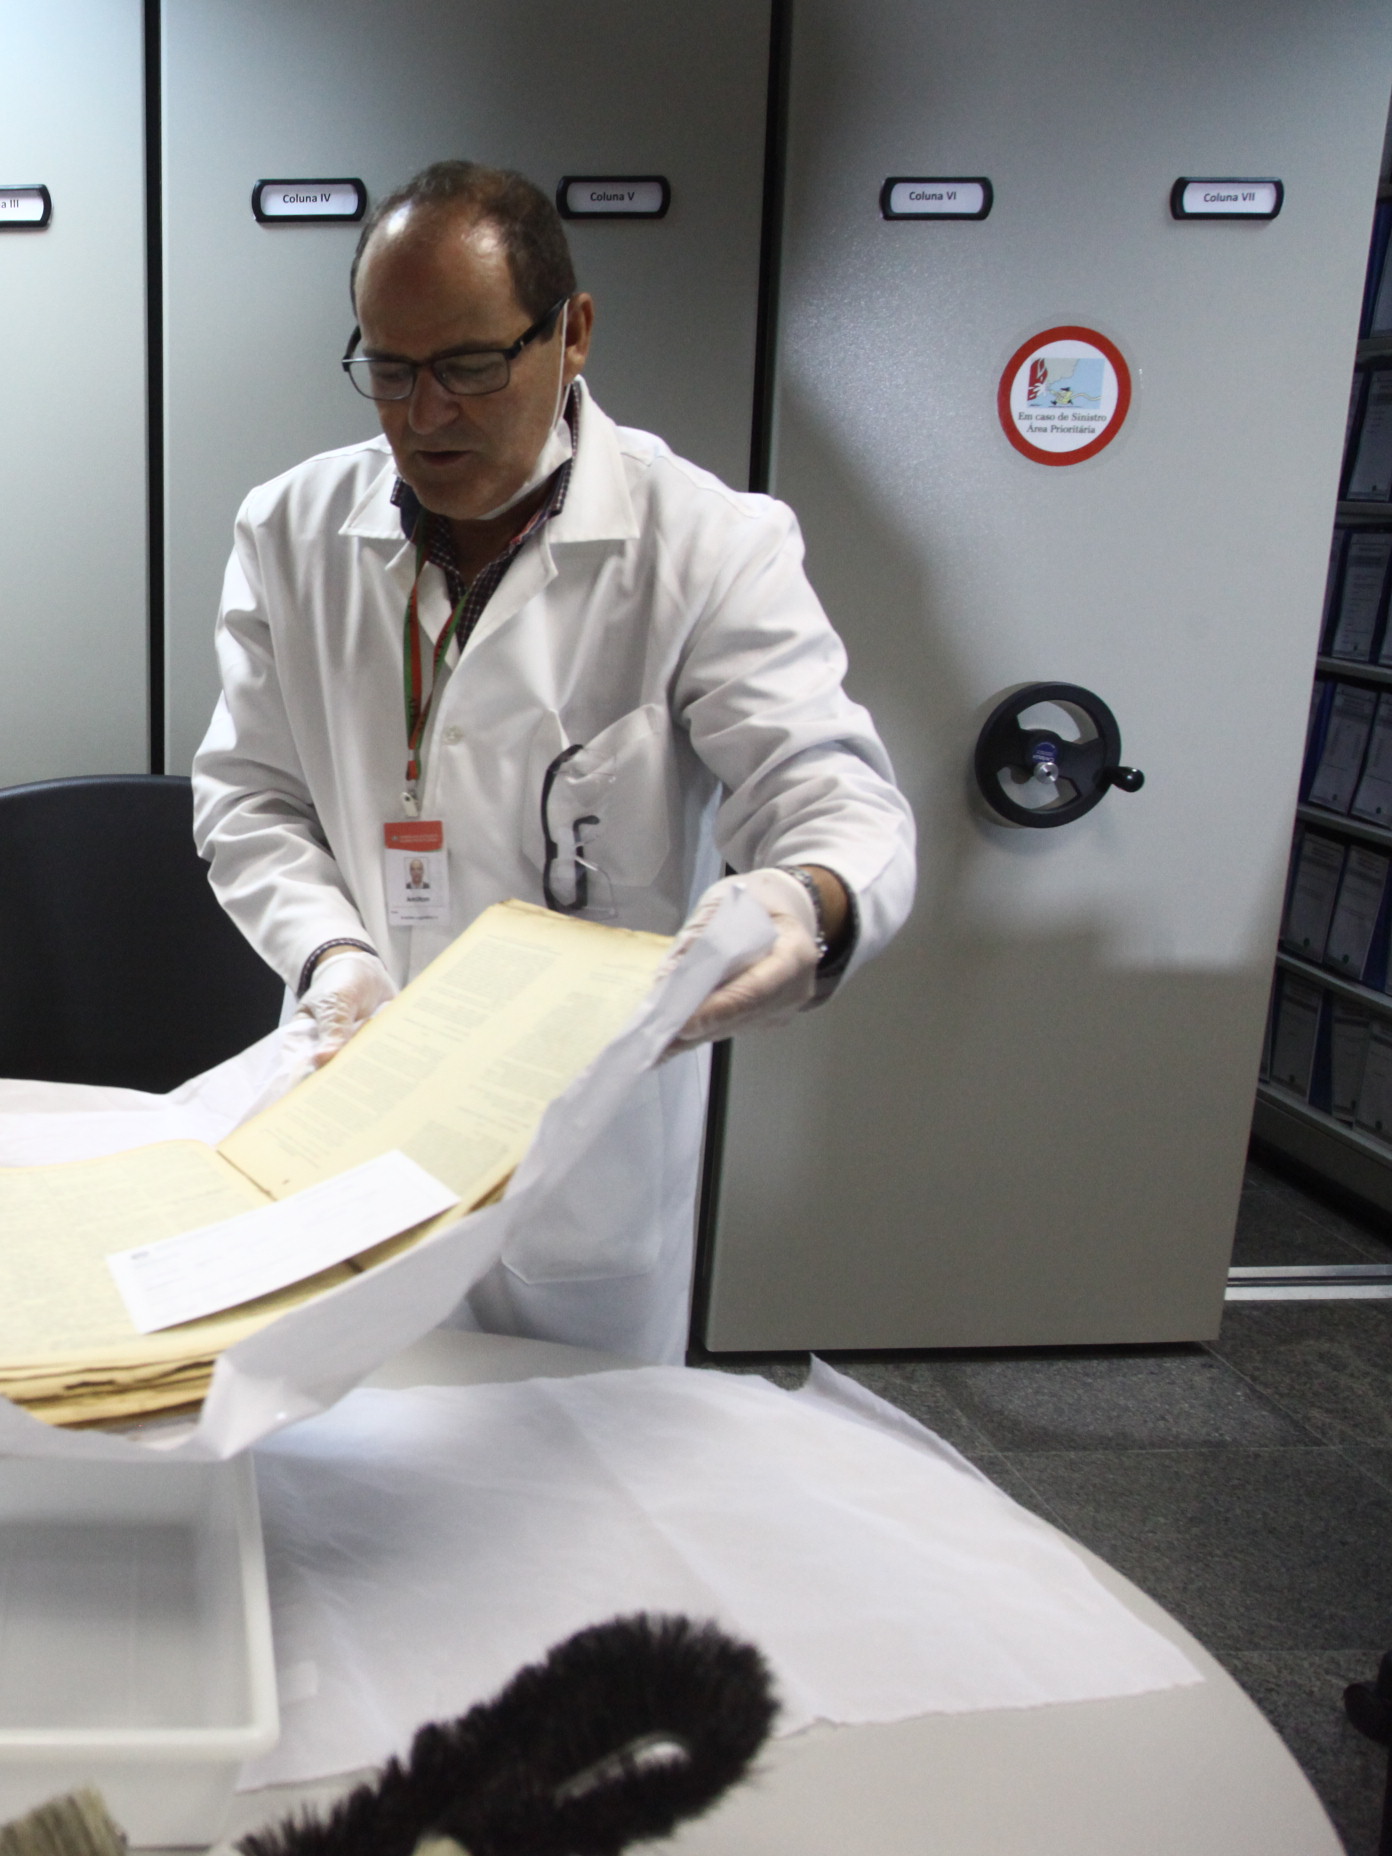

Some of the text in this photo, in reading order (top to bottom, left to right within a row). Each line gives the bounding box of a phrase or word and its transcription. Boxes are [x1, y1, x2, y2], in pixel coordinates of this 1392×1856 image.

[283, 193, 331, 203] Coluna IV
[590, 192, 625, 201] Coluna
[909, 191, 957, 201] Coluna VI
[1204, 192, 1255, 203] Coluna VII
[9, 199, 19, 208] III
[1018, 412, 1033, 420] Em
[1058, 412, 1068, 421] de
[1071, 412, 1107, 421] Sinistro
[1027, 423, 1095, 434] Área Prioritária
